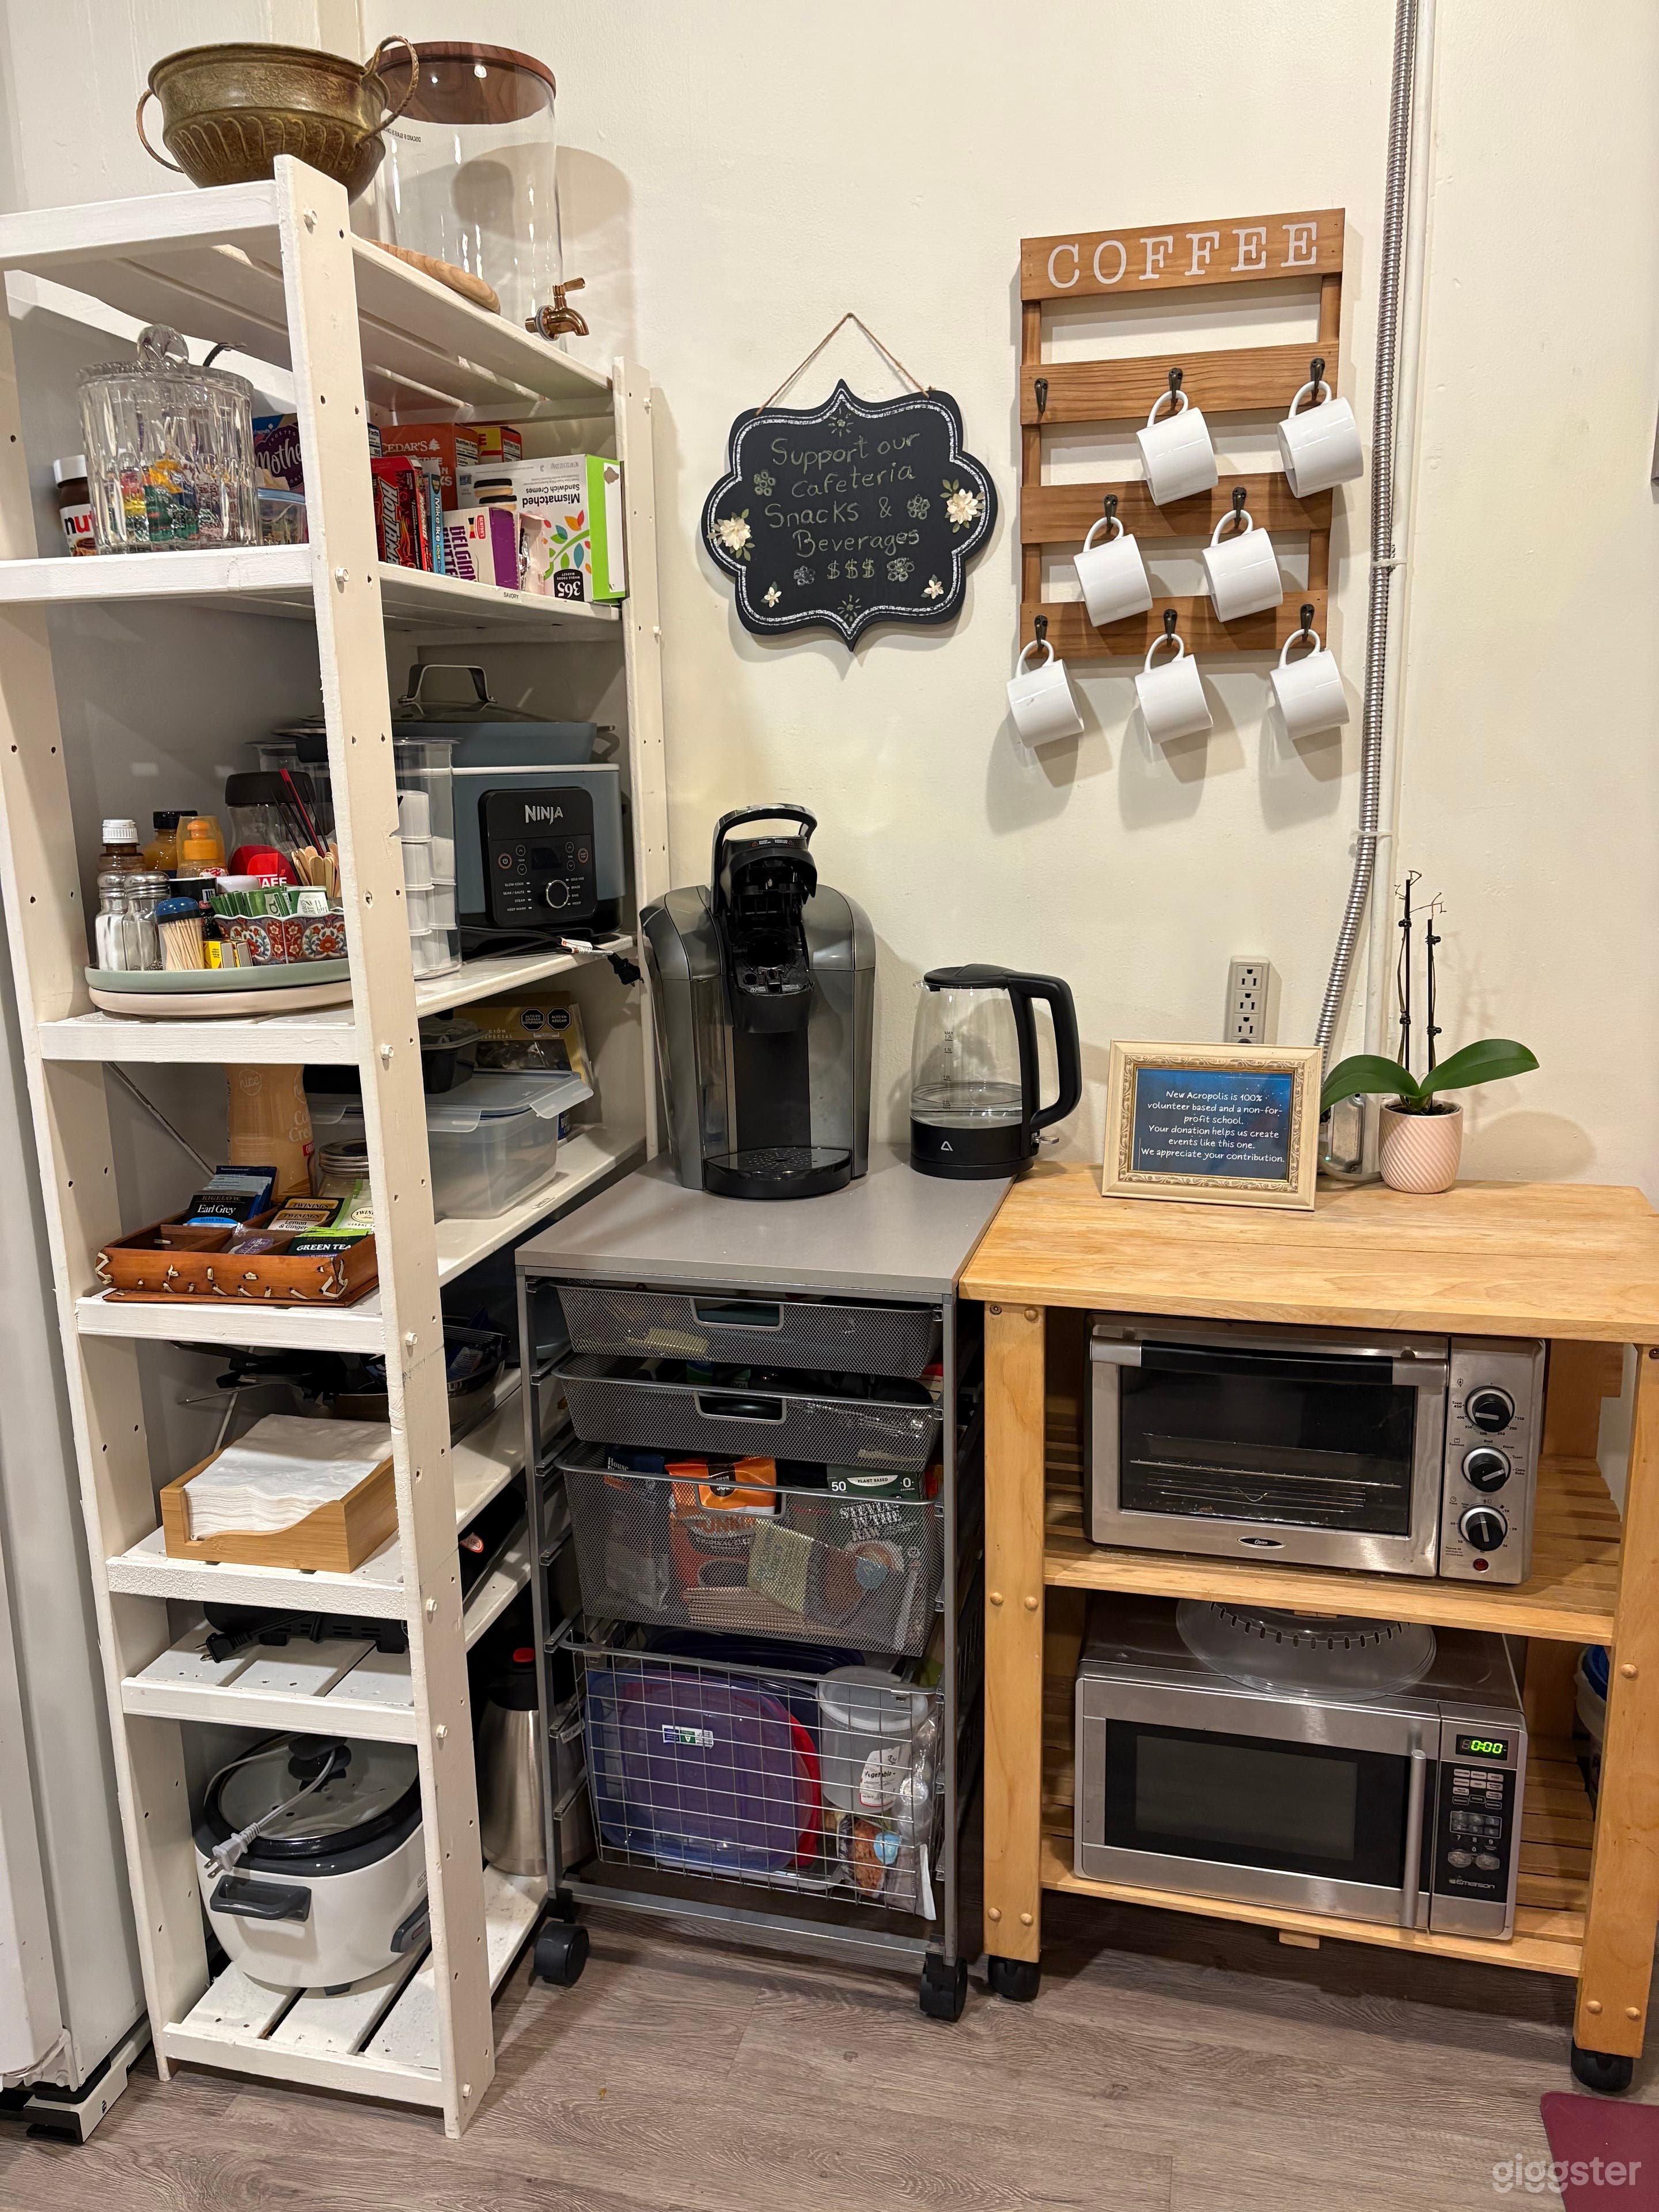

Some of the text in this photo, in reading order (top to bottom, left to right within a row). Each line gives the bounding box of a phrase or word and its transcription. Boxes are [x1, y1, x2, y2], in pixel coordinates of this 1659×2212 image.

[1047, 222, 1317, 289] COFFEE
[382, 441, 428, 454] CEDAR'S
[771, 432, 921, 474] Support our
[550, 484, 579, 493] Sandwich
[522, 493, 580, 508] Mismatched
[879, 497, 893, 519] &
[792, 528, 920, 558] Beverages
[557, 580, 581, 597] 365
[503, 592, 519, 600] SAVORY
[524, 804, 564, 825] NINJA
[1165, 1090, 1185, 1099] New
[1187, 1092, 1229, 1101] Acropolis
[1240, 1094, 1263, 1102] 100%
[1147, 1102, 1190, 1111] volunteer
[1192, 1103, 1217, 1112] based
[1218, 1104, 1235, 1113] and
[1244, 1106, 1283, 1115] non-for-
[1184, 1115, 1244, 1126] profit school.
[1148, 1124, 1169, 1133] Your
[1171, 1125, 1210, 1135] donation
[1212, 1127, 1235, 1138] helps
[1249, 1130, 1279, 1139] create
[1168, 1138, 1198, 1146] events
[1200, 1139, 1215, 1147] like
[1217, 1139, 1234, 1148] this
[1141, 1147, 1285, 1163] We appreciate your contribution.
[197, 1205, 237, 1215] Earl Grey
[831, 1480, 847, 1492] 50
[903, 1477, 912, 1488] 0
[1471, 1738, 1503, 1755] 0:00
[1456, 1879, 1495, 1889] Emerson
